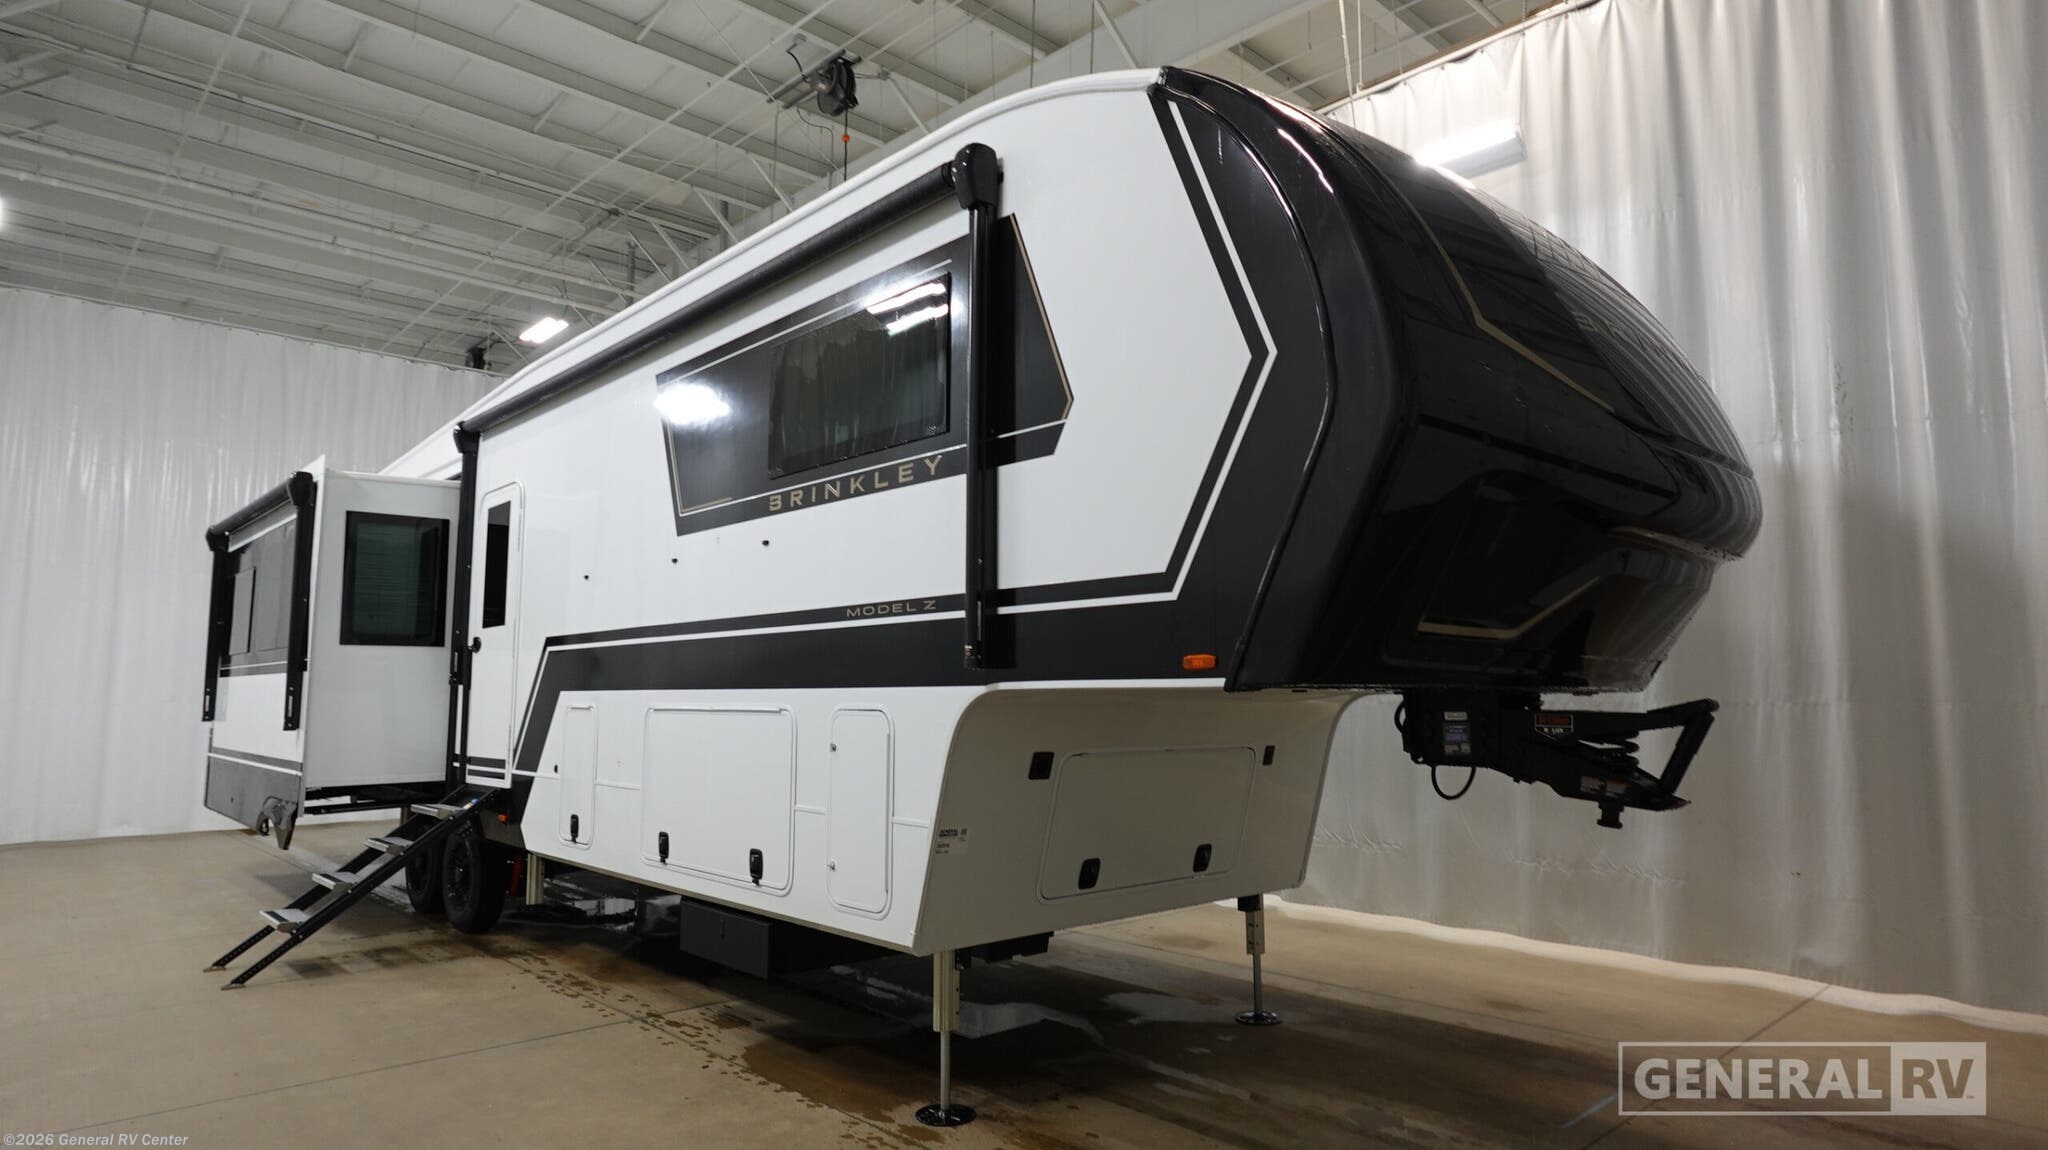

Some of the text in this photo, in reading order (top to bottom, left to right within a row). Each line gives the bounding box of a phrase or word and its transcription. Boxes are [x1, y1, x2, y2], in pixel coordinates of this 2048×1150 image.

[769, 454, 943, 512] BRINKLEY
[846, 599, 937, 618] MODEL Z
